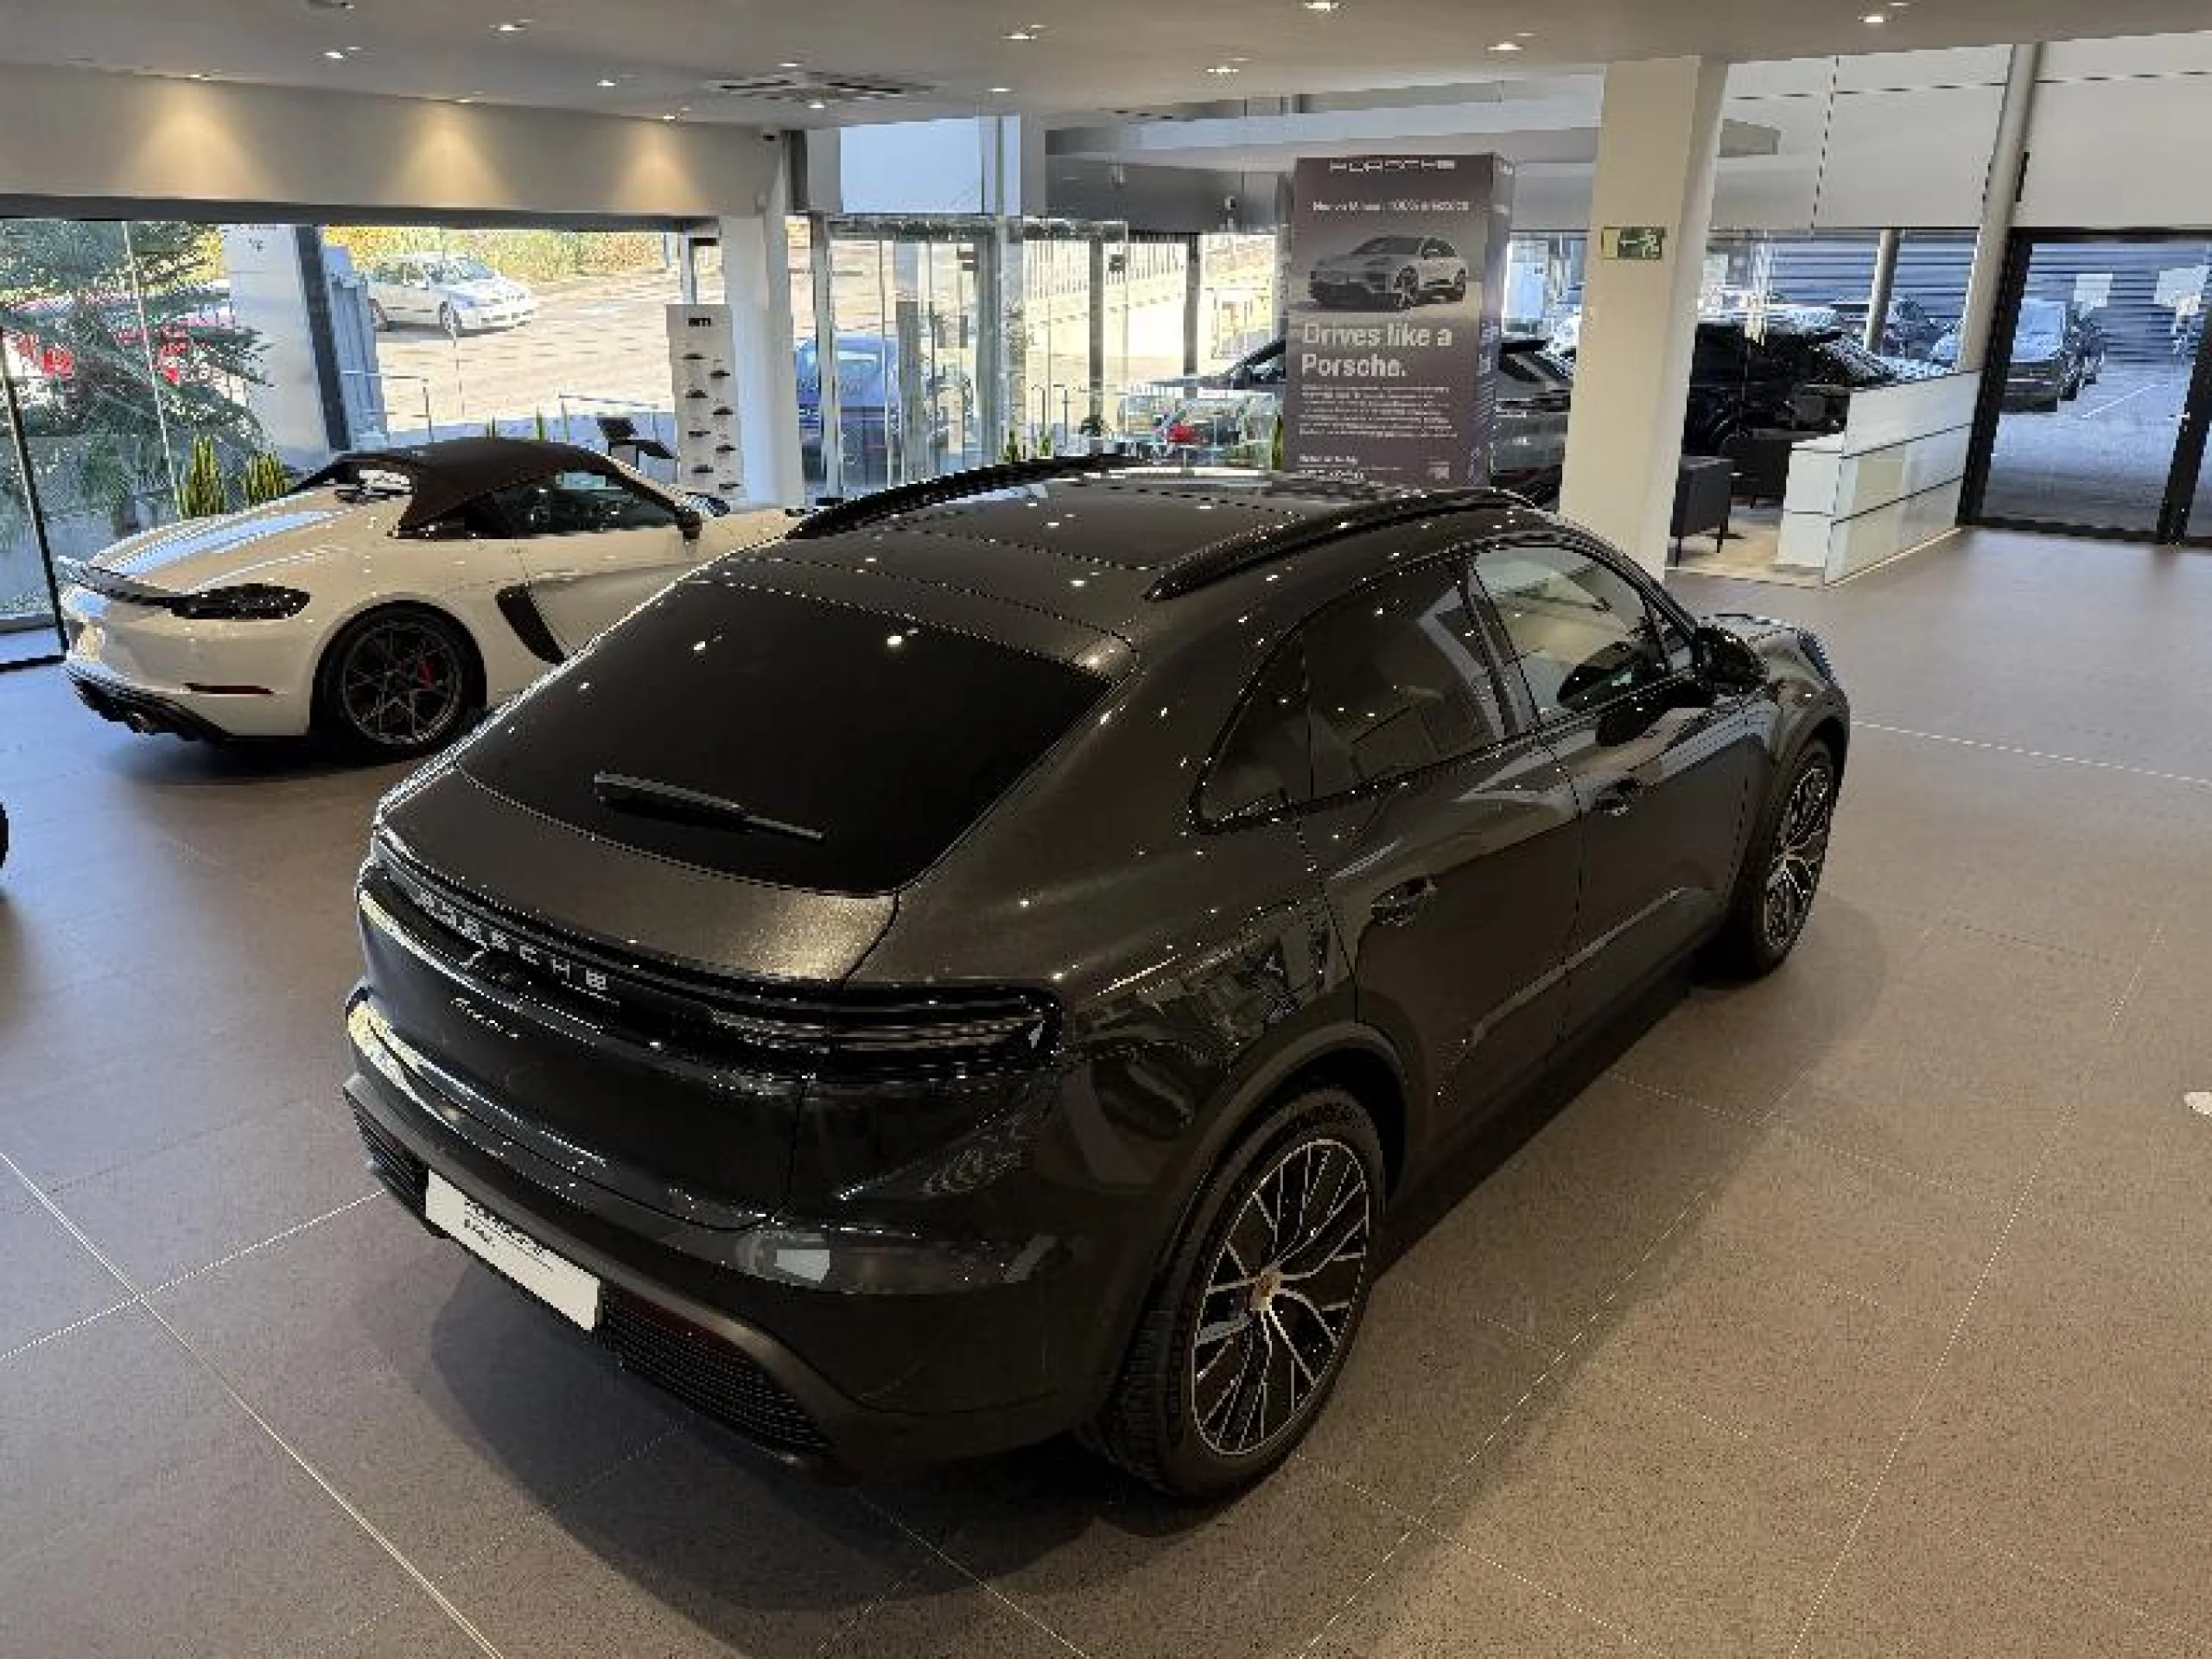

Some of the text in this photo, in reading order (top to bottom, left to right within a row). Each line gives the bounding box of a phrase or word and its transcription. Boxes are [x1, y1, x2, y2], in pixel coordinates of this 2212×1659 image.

[1302, 322, 1381, 346] Drives
[1387, 322, 1430, 346] like
[1437, 328, 1452, 346] a
